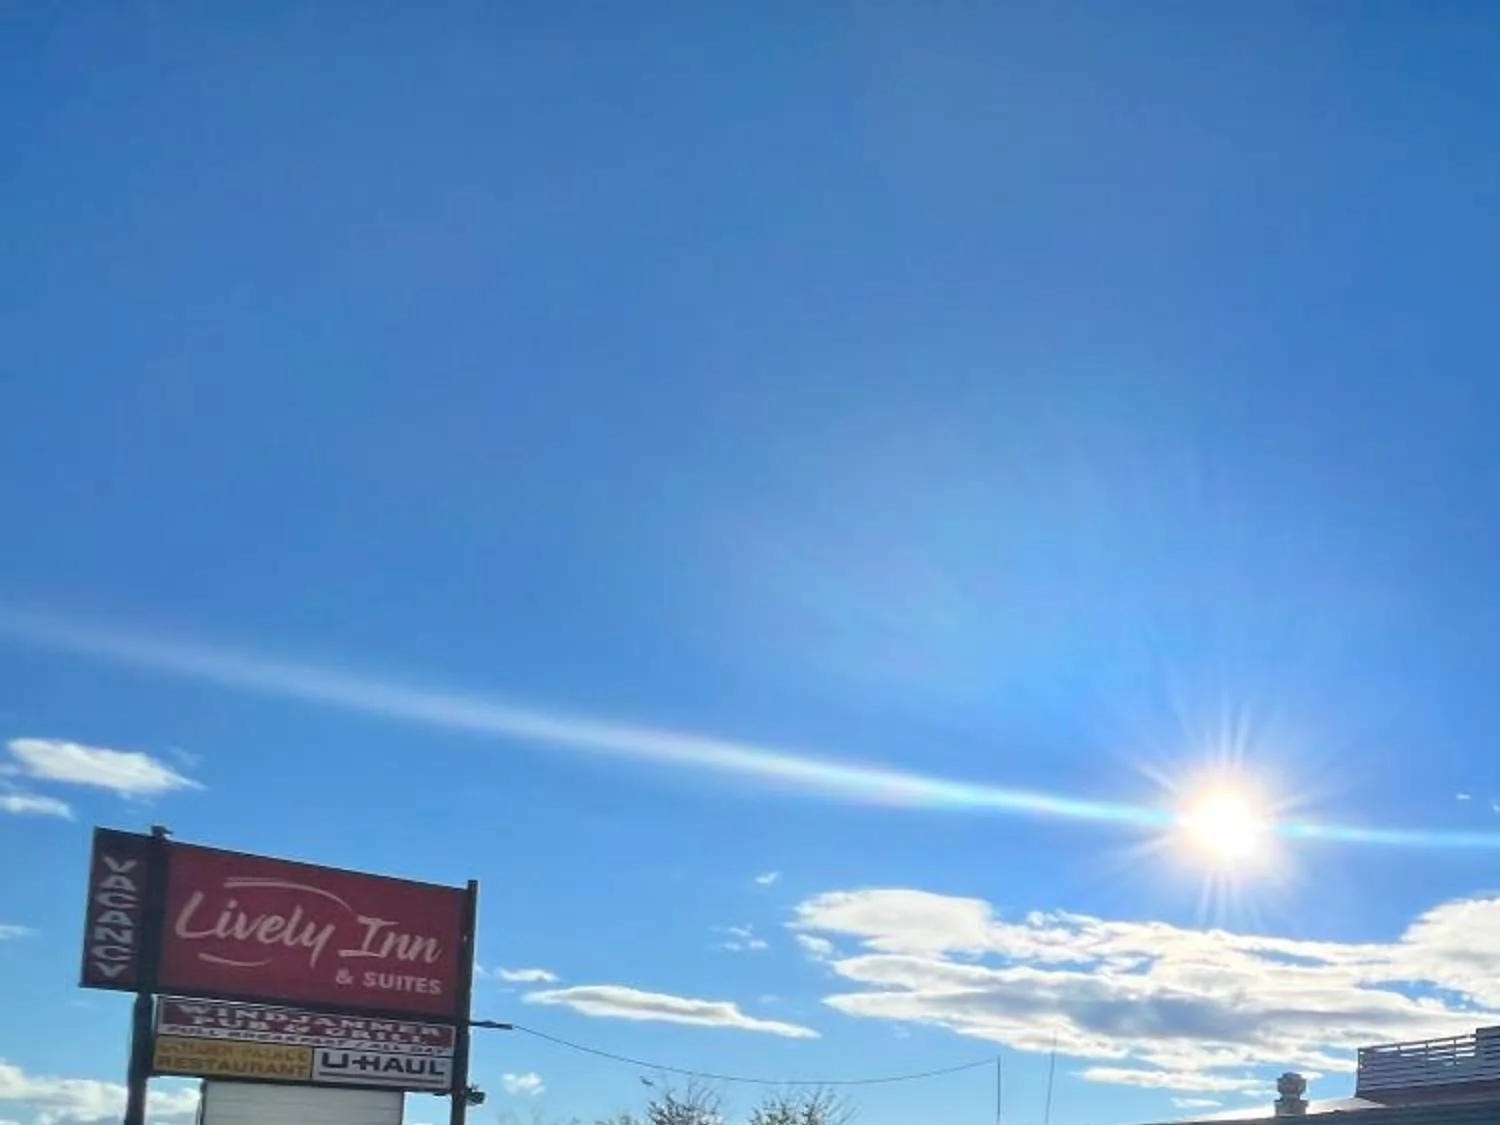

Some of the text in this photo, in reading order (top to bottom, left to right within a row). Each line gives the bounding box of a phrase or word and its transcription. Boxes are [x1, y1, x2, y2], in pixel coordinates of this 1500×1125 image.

[95, 856, 137, 977] VACANCY
[174, 892, 441, 967] Lively Inn
[335, 970, 442, 995] & SUITES
[179, 1003, 441, 1036] WINDJAMMER
[155, 1055, 309, 1076] RESTAURANT
[321, 1052, 445, 1075] U-HAUL
